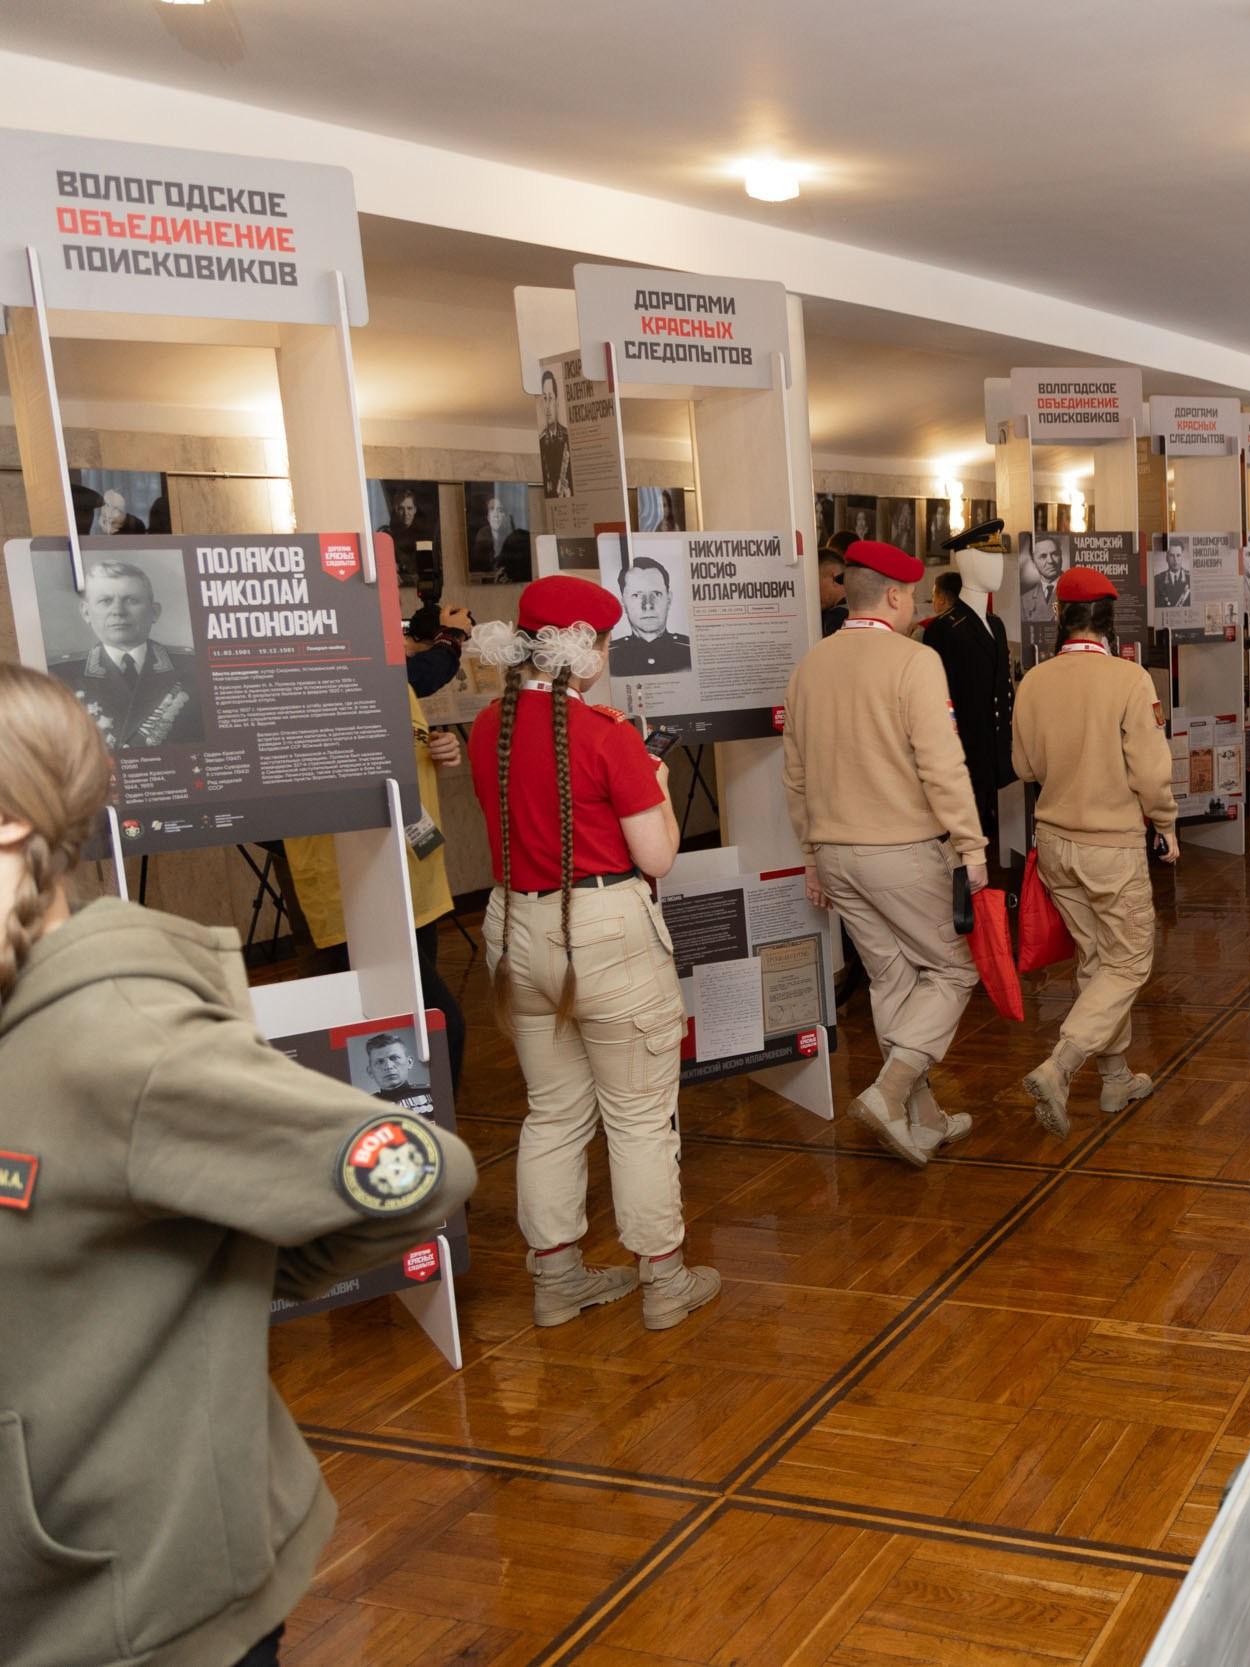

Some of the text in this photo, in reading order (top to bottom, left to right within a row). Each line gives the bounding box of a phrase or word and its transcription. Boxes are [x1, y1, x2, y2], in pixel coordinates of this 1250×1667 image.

[56, 169, 288, 218] ВОЛОГОДСКОЕ
[56, 206, 296, 253] ОБЪЕДИНЕНИЕ
[62, 244, 298, 287] ПОИСКОВИКОВ
[634, 289, 736, 315] ДОРОГАМИ
[641, 316, 734, 340] КРАСНЫХ
[624, 340, 753, 365] СЛЕДОПЫТОВ
[1038, 382, 1117, 396] ВОЛОГОДСКОЕ
[1037, 397, 1119, 410] ОБЪЕДИНЕНИЕ
[1174, 407, 1218, 418] ДОРОГАМИ
[1039, 412, 1119, 424] ПОИСКОВИКОВ
[1177, 421, 1217, 431] КРАСНЫХ
[1169, 433, 1225, 445] СЛЕДОПЫТОВ
[688, 536, 781, 558] НИКИТИНСКИЙ
[1074, 535, 1123, 549] ЧАРОМСКИЙ
[196, 546, 305, 574] ПОЛЯКОВ
[1075, 549, 1109, 562] АЛЕКСЕЙ
[690, 562, 737, 580] ИОСИФ
[200, 573, 309, 607] НИКОЛАЙ
[692, 581, 795, 601] ИЛЛАРИОНОВИЧ
[207, 609, 338, 640] АНТОНОВИЧ
[353, 1126, 396, 1164] ВОП
